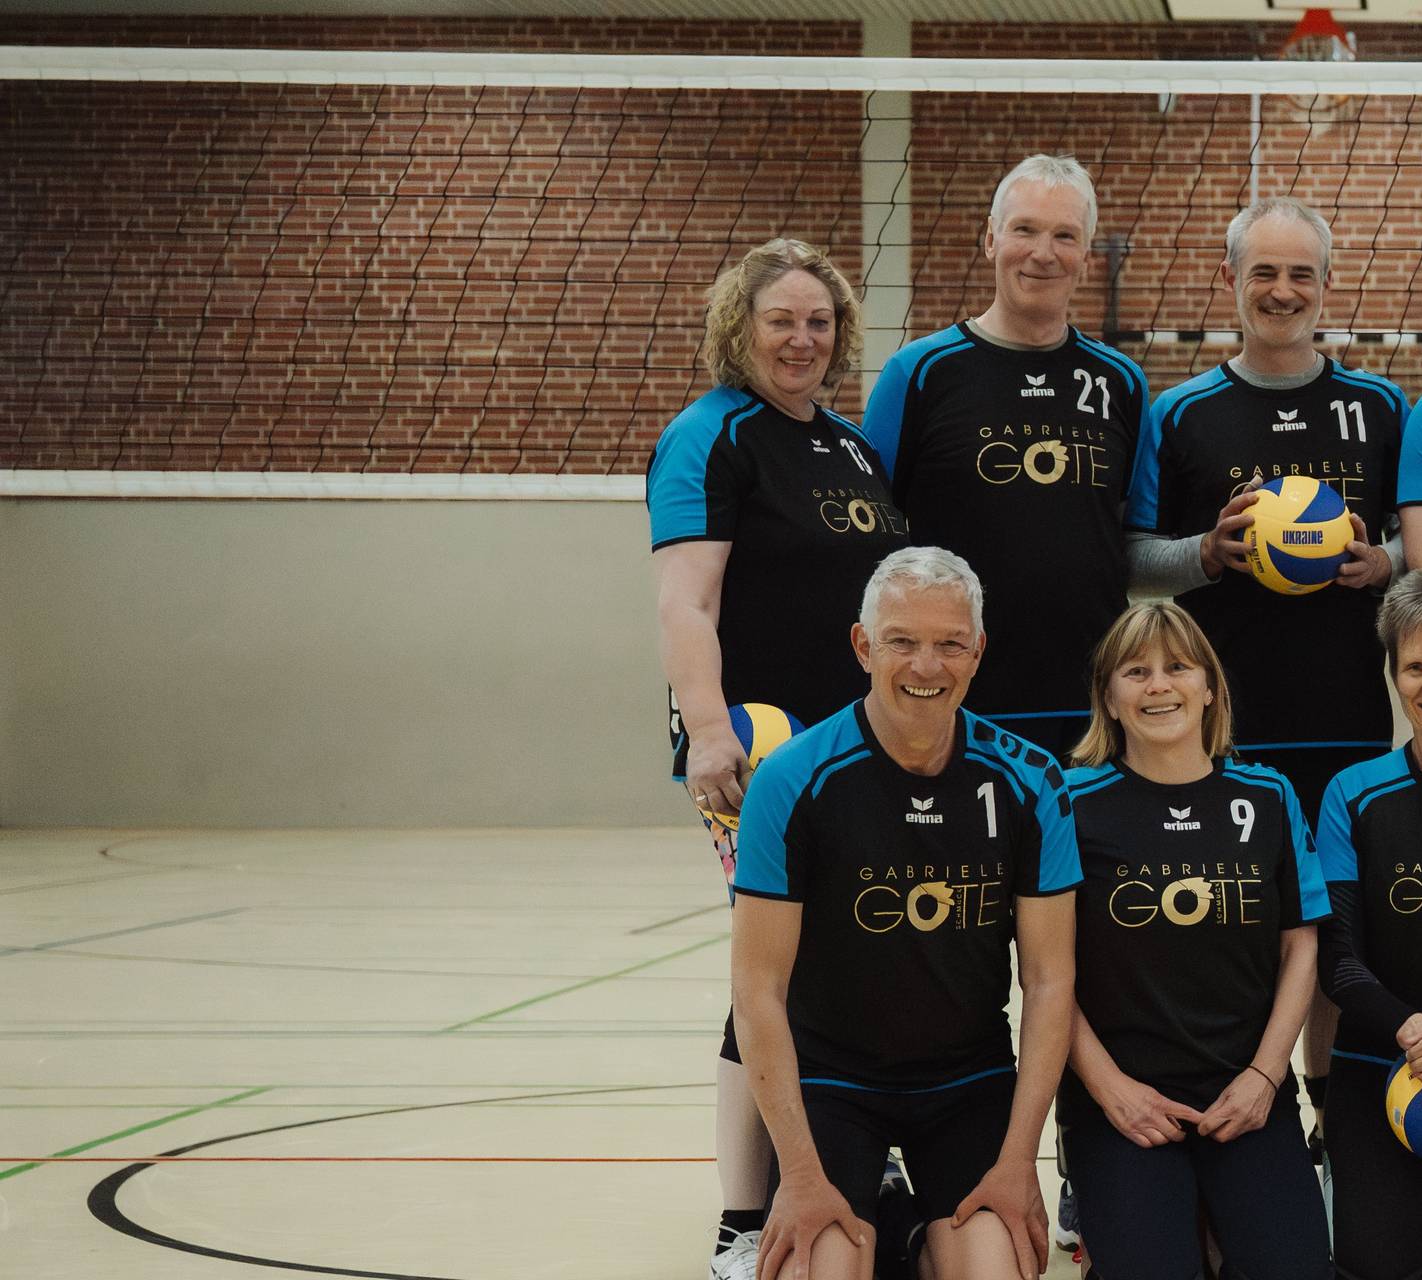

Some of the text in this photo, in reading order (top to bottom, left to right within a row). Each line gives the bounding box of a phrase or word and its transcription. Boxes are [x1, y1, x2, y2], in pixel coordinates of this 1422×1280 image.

[1021, 387, 1056, 398] erima
[1073, 368, 1112, 421] 21
[1272, 421, 1308, 433] erima
[1329, 400, 1367, 443] 11
[978, 424, 1106, 442] GABRIELE
[1229, 461, 1364, 479] GABRIELE
[905, 812, 944, 824] erima
[976, 781, 998, 839] 1
[1163, 820, 1202, 831] erima
[1229, 798, 1256, 843] 9
[859, 862, 1004, 881] GABRIELE
[1116, 862, 1260, 878] GABRIELE
